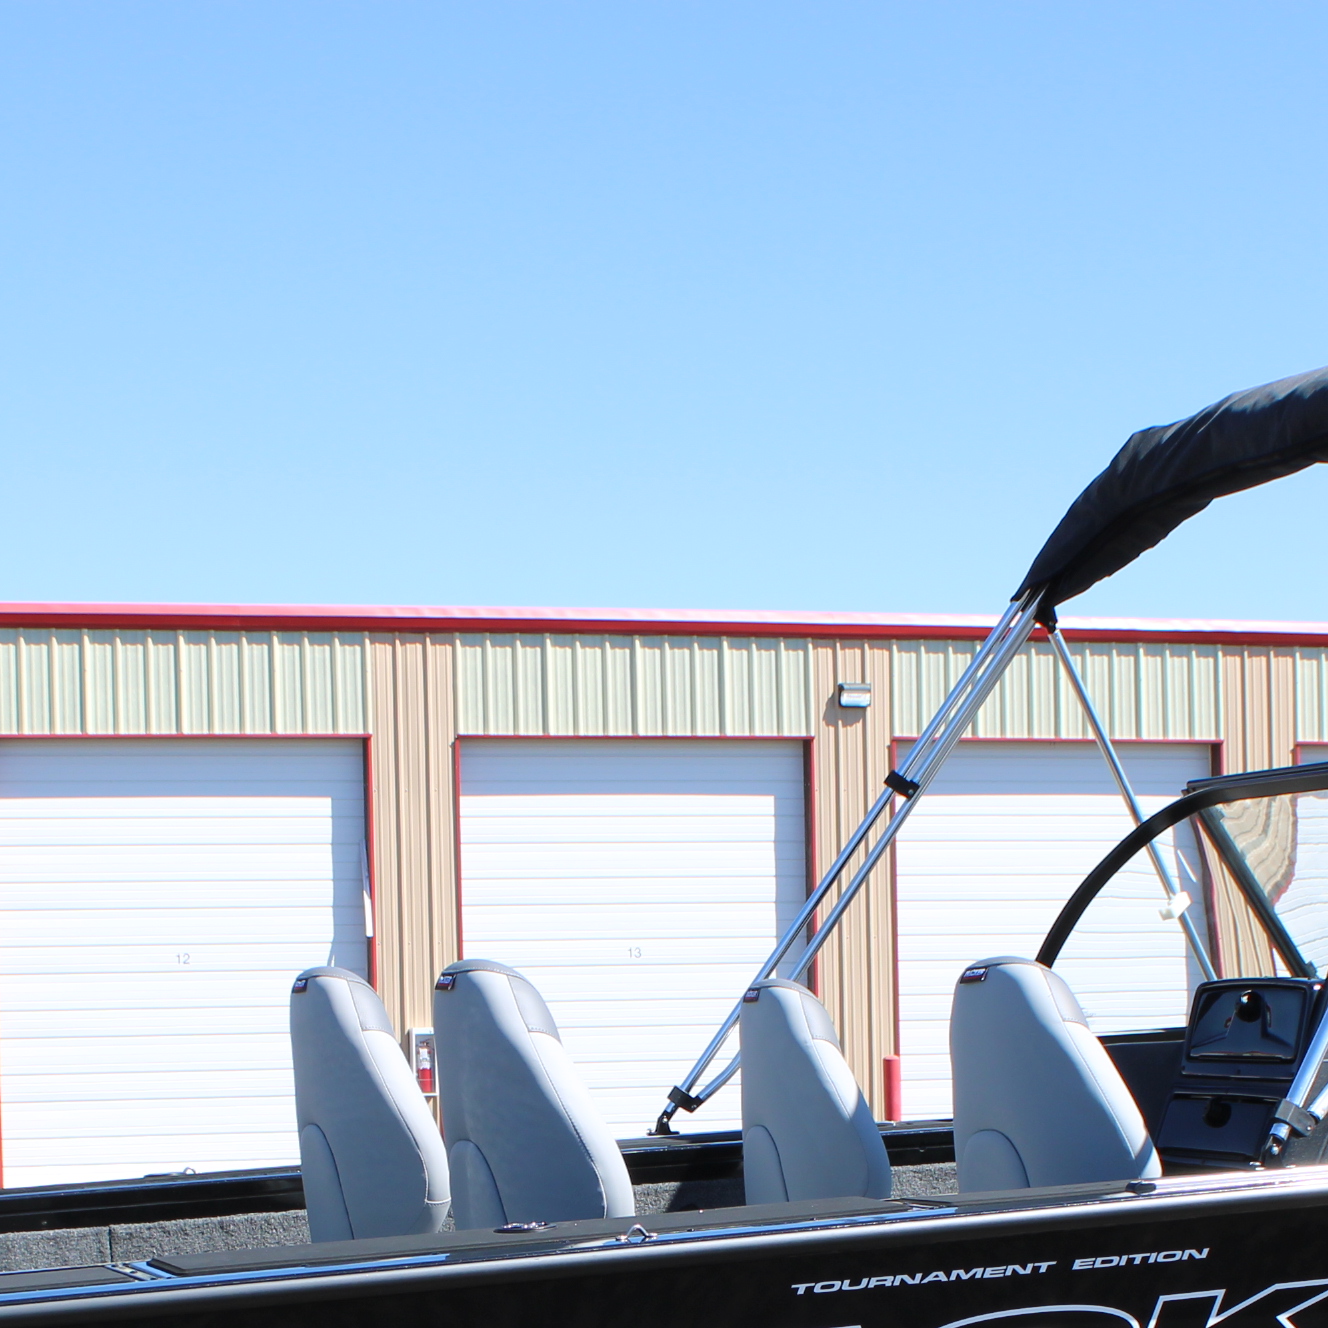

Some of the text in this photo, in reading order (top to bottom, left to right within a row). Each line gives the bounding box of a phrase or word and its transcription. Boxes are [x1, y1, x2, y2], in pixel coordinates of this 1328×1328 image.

[175, 952, 190, 965] 12
[628, 946, 642, 959] 13
[791, 1247, 1210, 1296] TOURNAMENT EDITION
